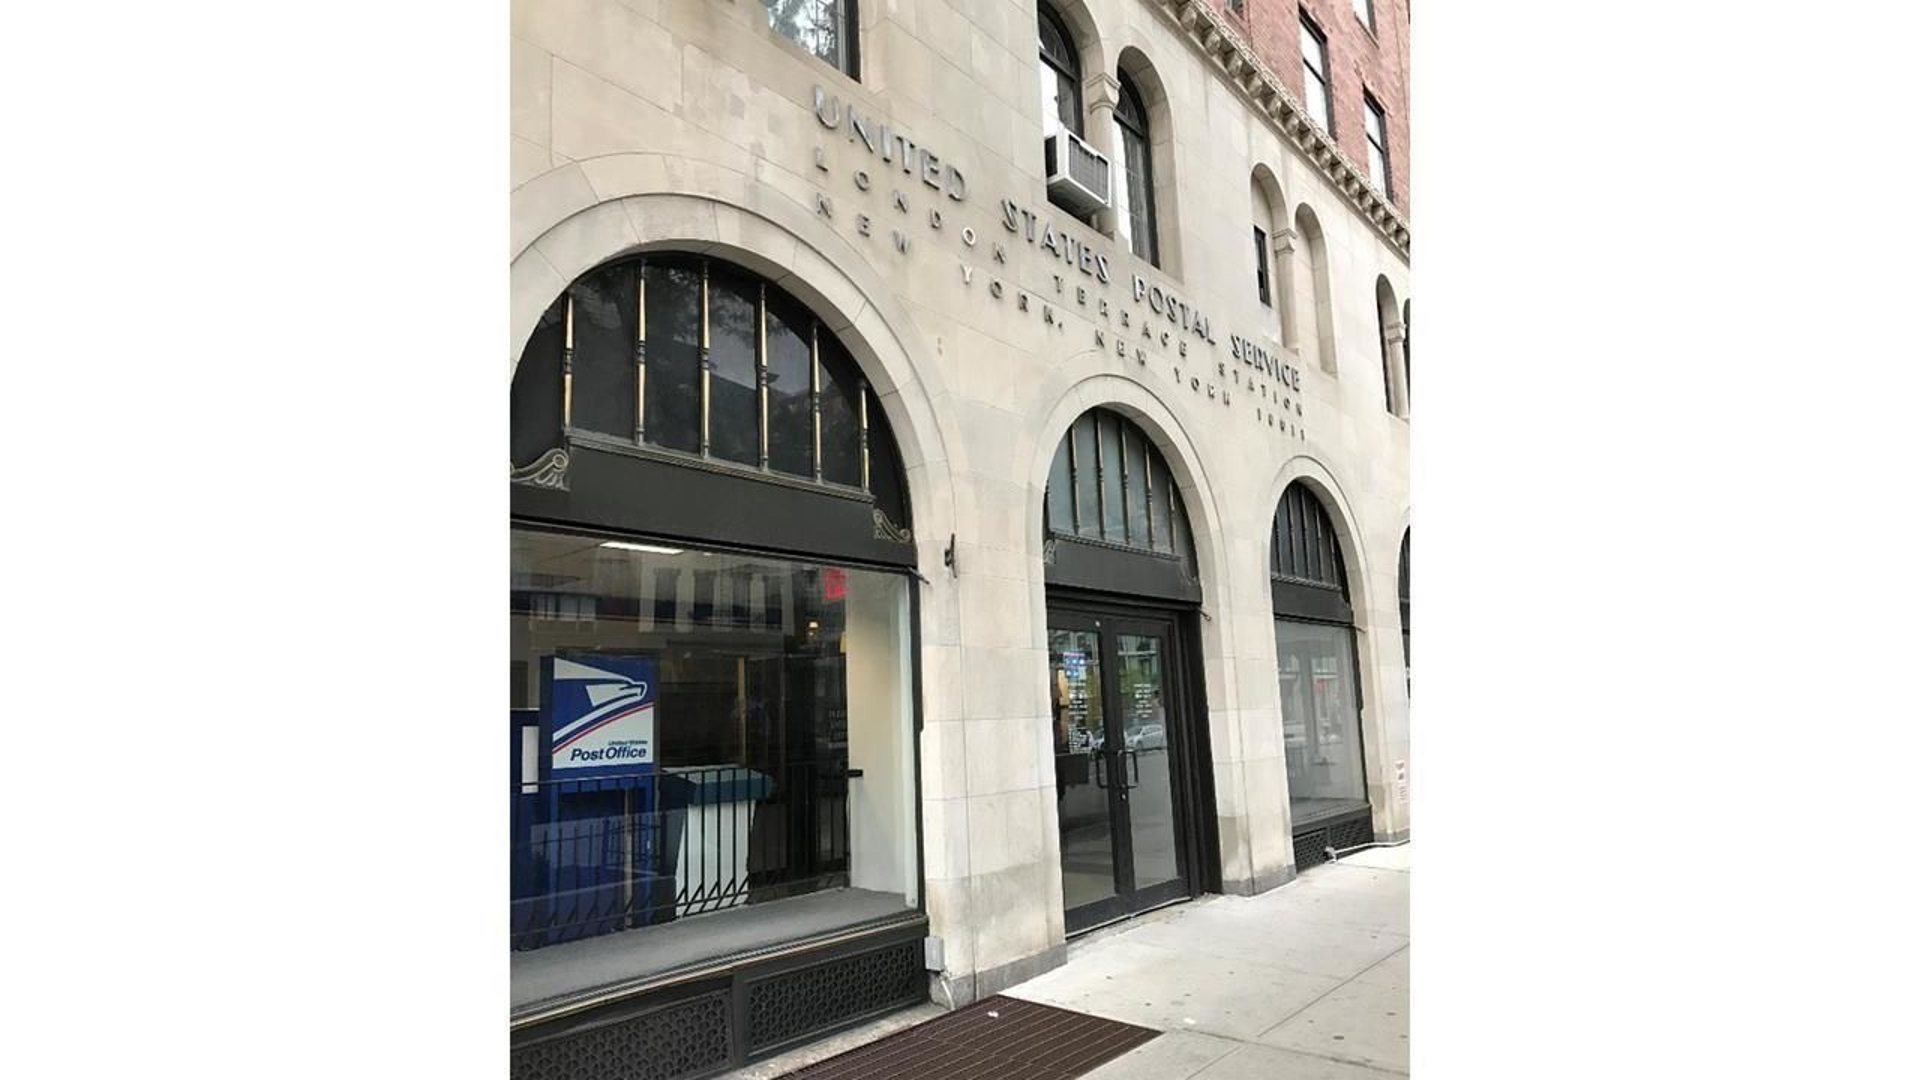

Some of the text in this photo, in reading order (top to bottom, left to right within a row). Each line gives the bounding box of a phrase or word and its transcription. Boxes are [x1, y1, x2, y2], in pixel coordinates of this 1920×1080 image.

[814, 84, 1301, 392] UNITED STATES POSTAL SERVICE
[815, 146, 1303, 417] LONDON TERRACE STATION
[816, 191, 911, 255] NEW
[1095, 329, 1147, 366] NEW
[1173, 366, 1231, 407] YORK
[1256, 407, 1305, 442] 10011
[570, 746, 647, 762] Post Office
